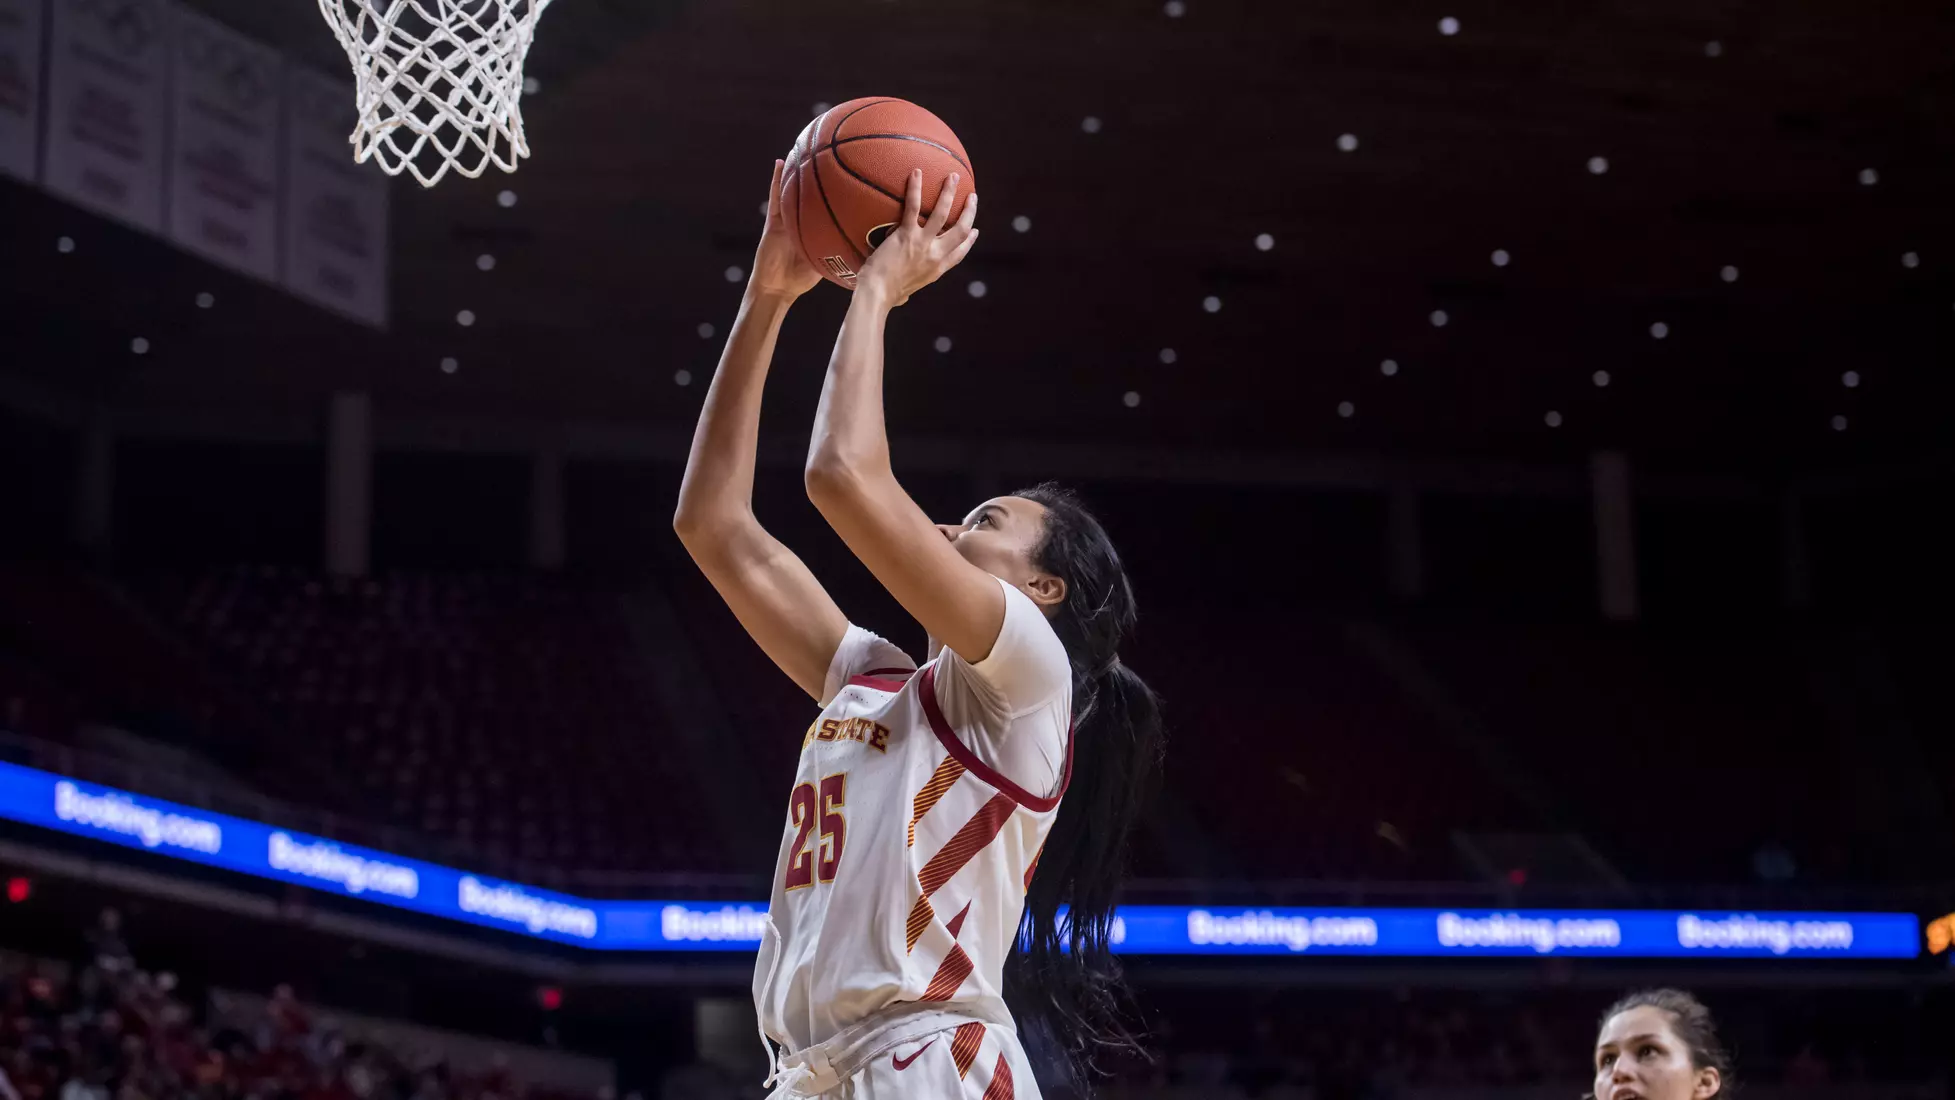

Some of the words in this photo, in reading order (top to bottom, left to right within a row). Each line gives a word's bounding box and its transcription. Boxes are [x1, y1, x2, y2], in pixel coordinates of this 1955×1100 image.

[816, 717, 890, 754] STATE
[55, 781, 221, 854] Booking.com
[785, 772, 848, 891] 25
[268, 831, 418, 899] Booking.com
[458, 875, 597, 939] Booking.com
[1186, 909, 1378, 951] Booking.com
[1436, 912, 1621, 953] Booking.com
[1677, 913, 1854, 954] Booking.com
